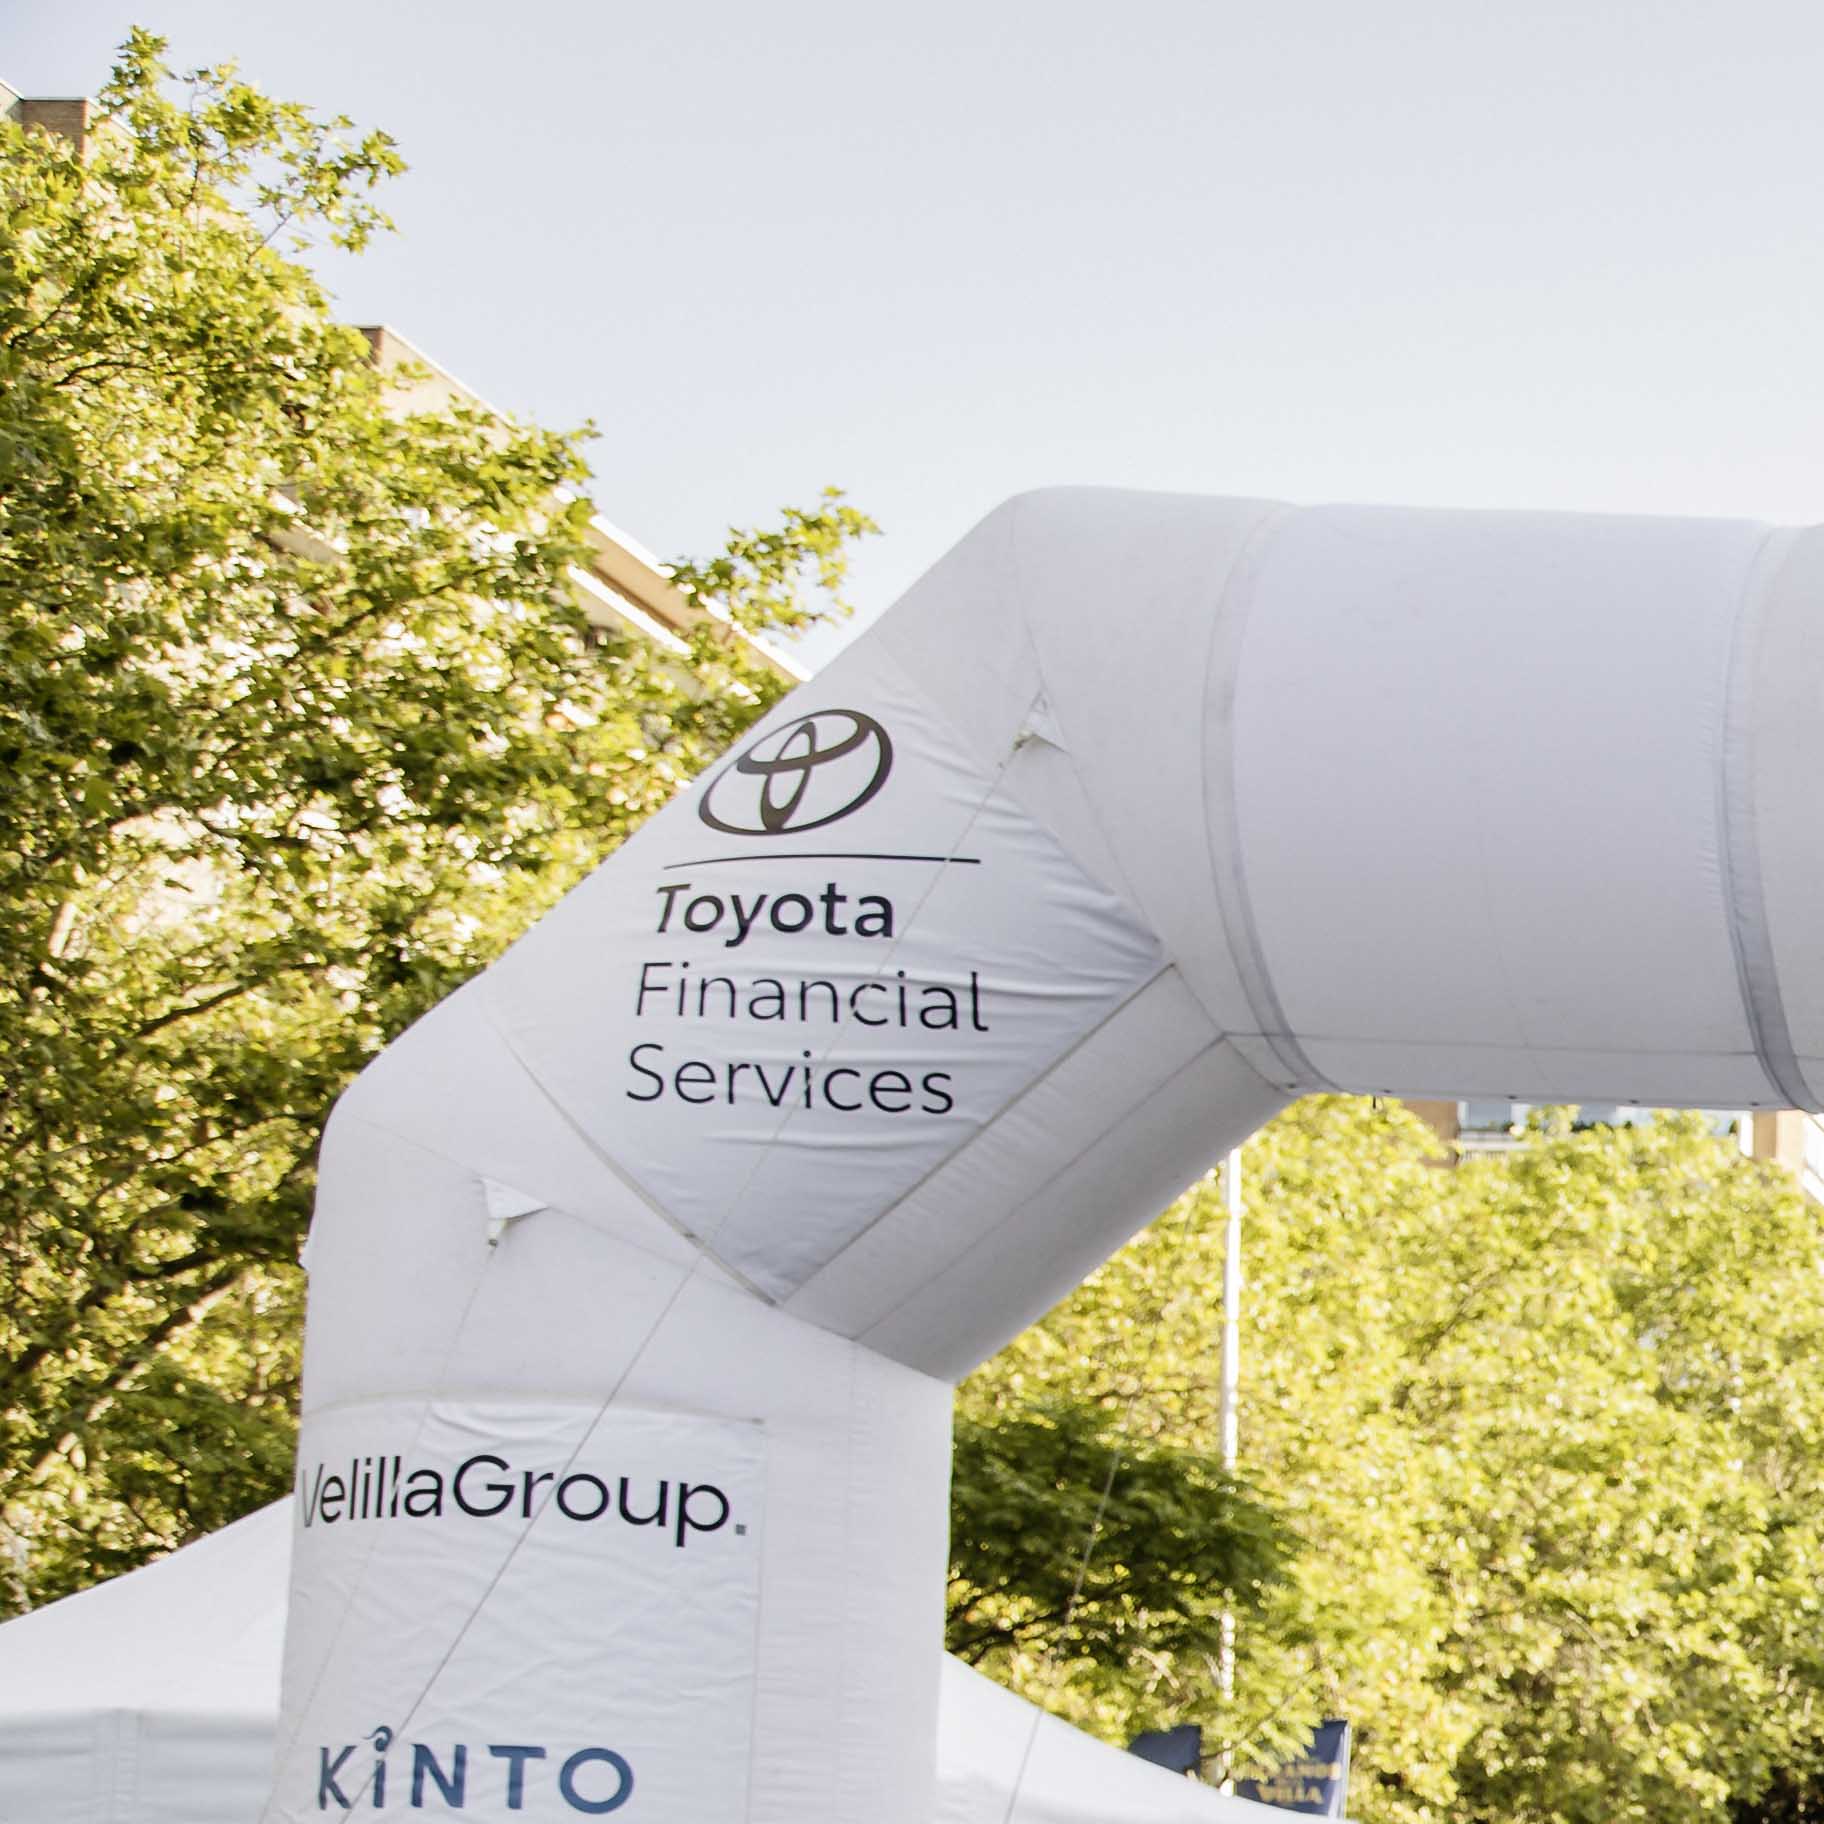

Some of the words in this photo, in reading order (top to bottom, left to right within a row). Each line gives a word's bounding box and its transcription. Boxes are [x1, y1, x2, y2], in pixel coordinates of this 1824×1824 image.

[655, 880, 894, 948] Toyota
[635, 960, 989, 1032] Financial
[625, 1044, 955, 1115] Services
